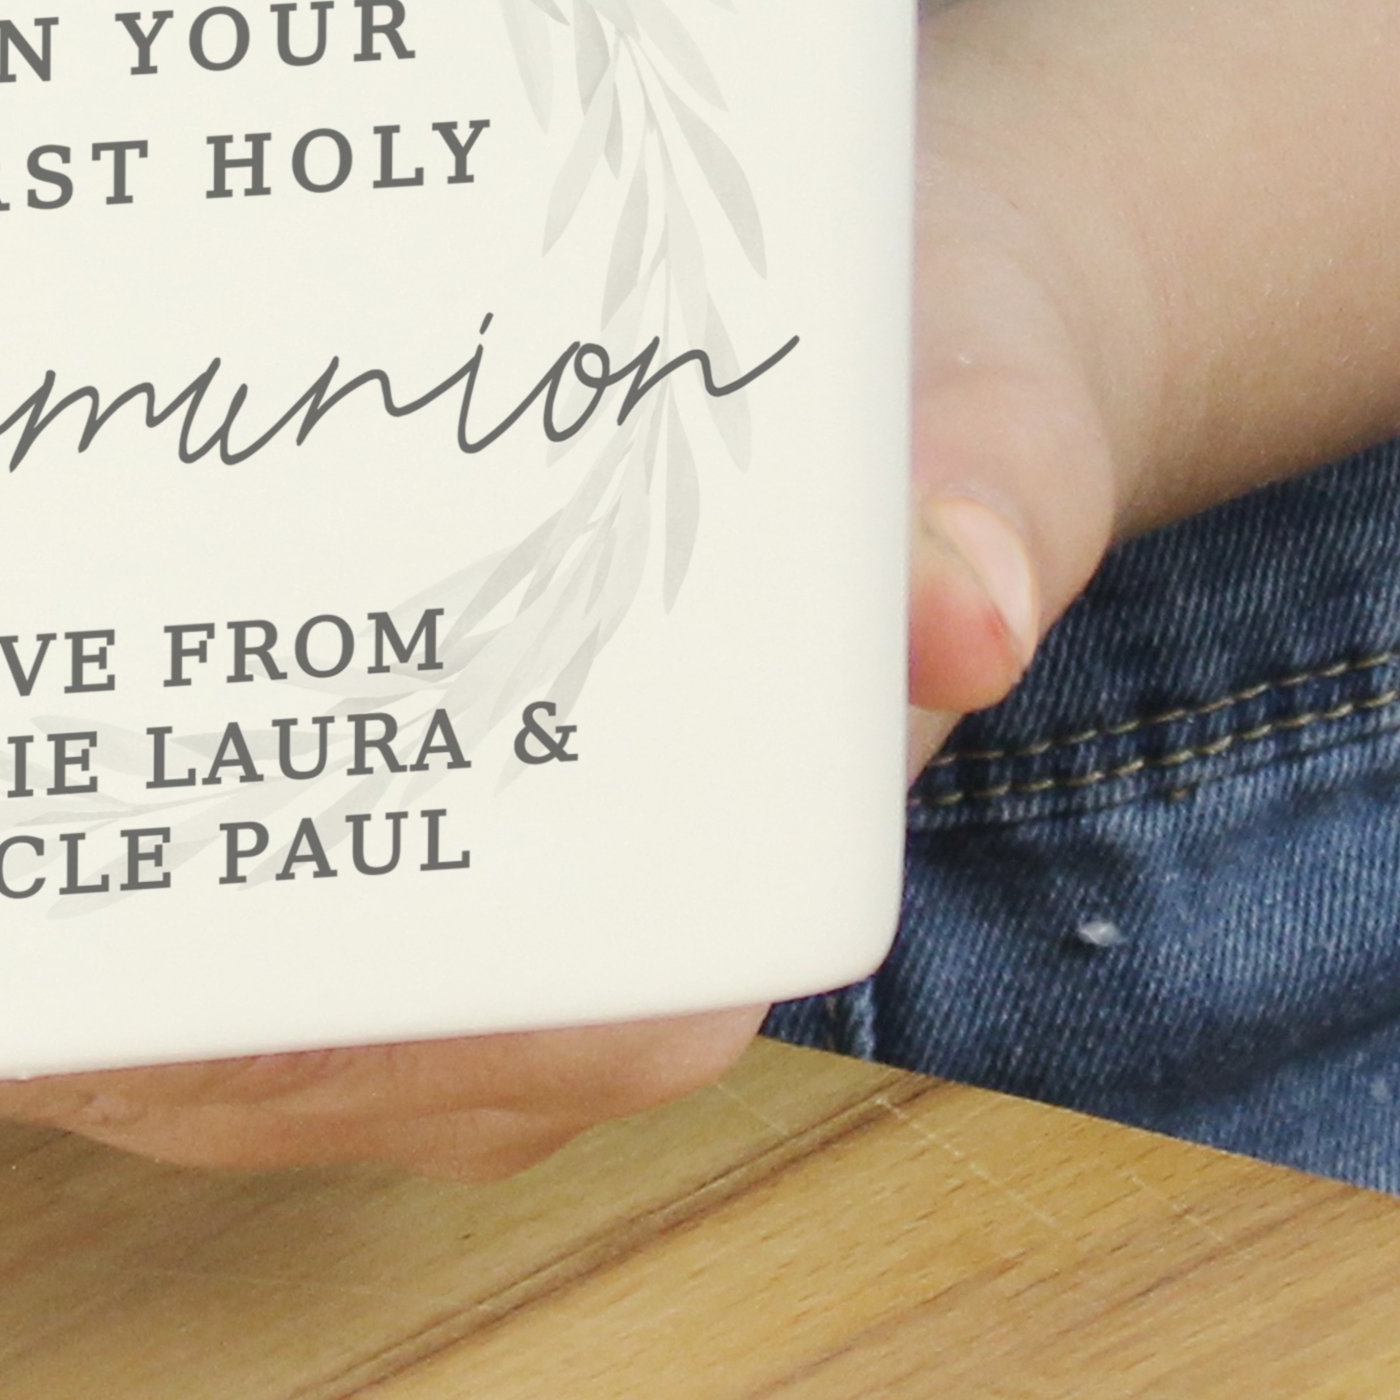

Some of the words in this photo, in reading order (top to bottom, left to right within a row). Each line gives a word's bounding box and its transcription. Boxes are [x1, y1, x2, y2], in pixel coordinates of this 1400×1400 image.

[206, 119, 490, 199] HOLY
[163, 608, 444, 687] FROM
[146, 708, 472, 789] LAURA
[514, 701, 579, 765] &
[219, 808, 470, 885] PAUL
